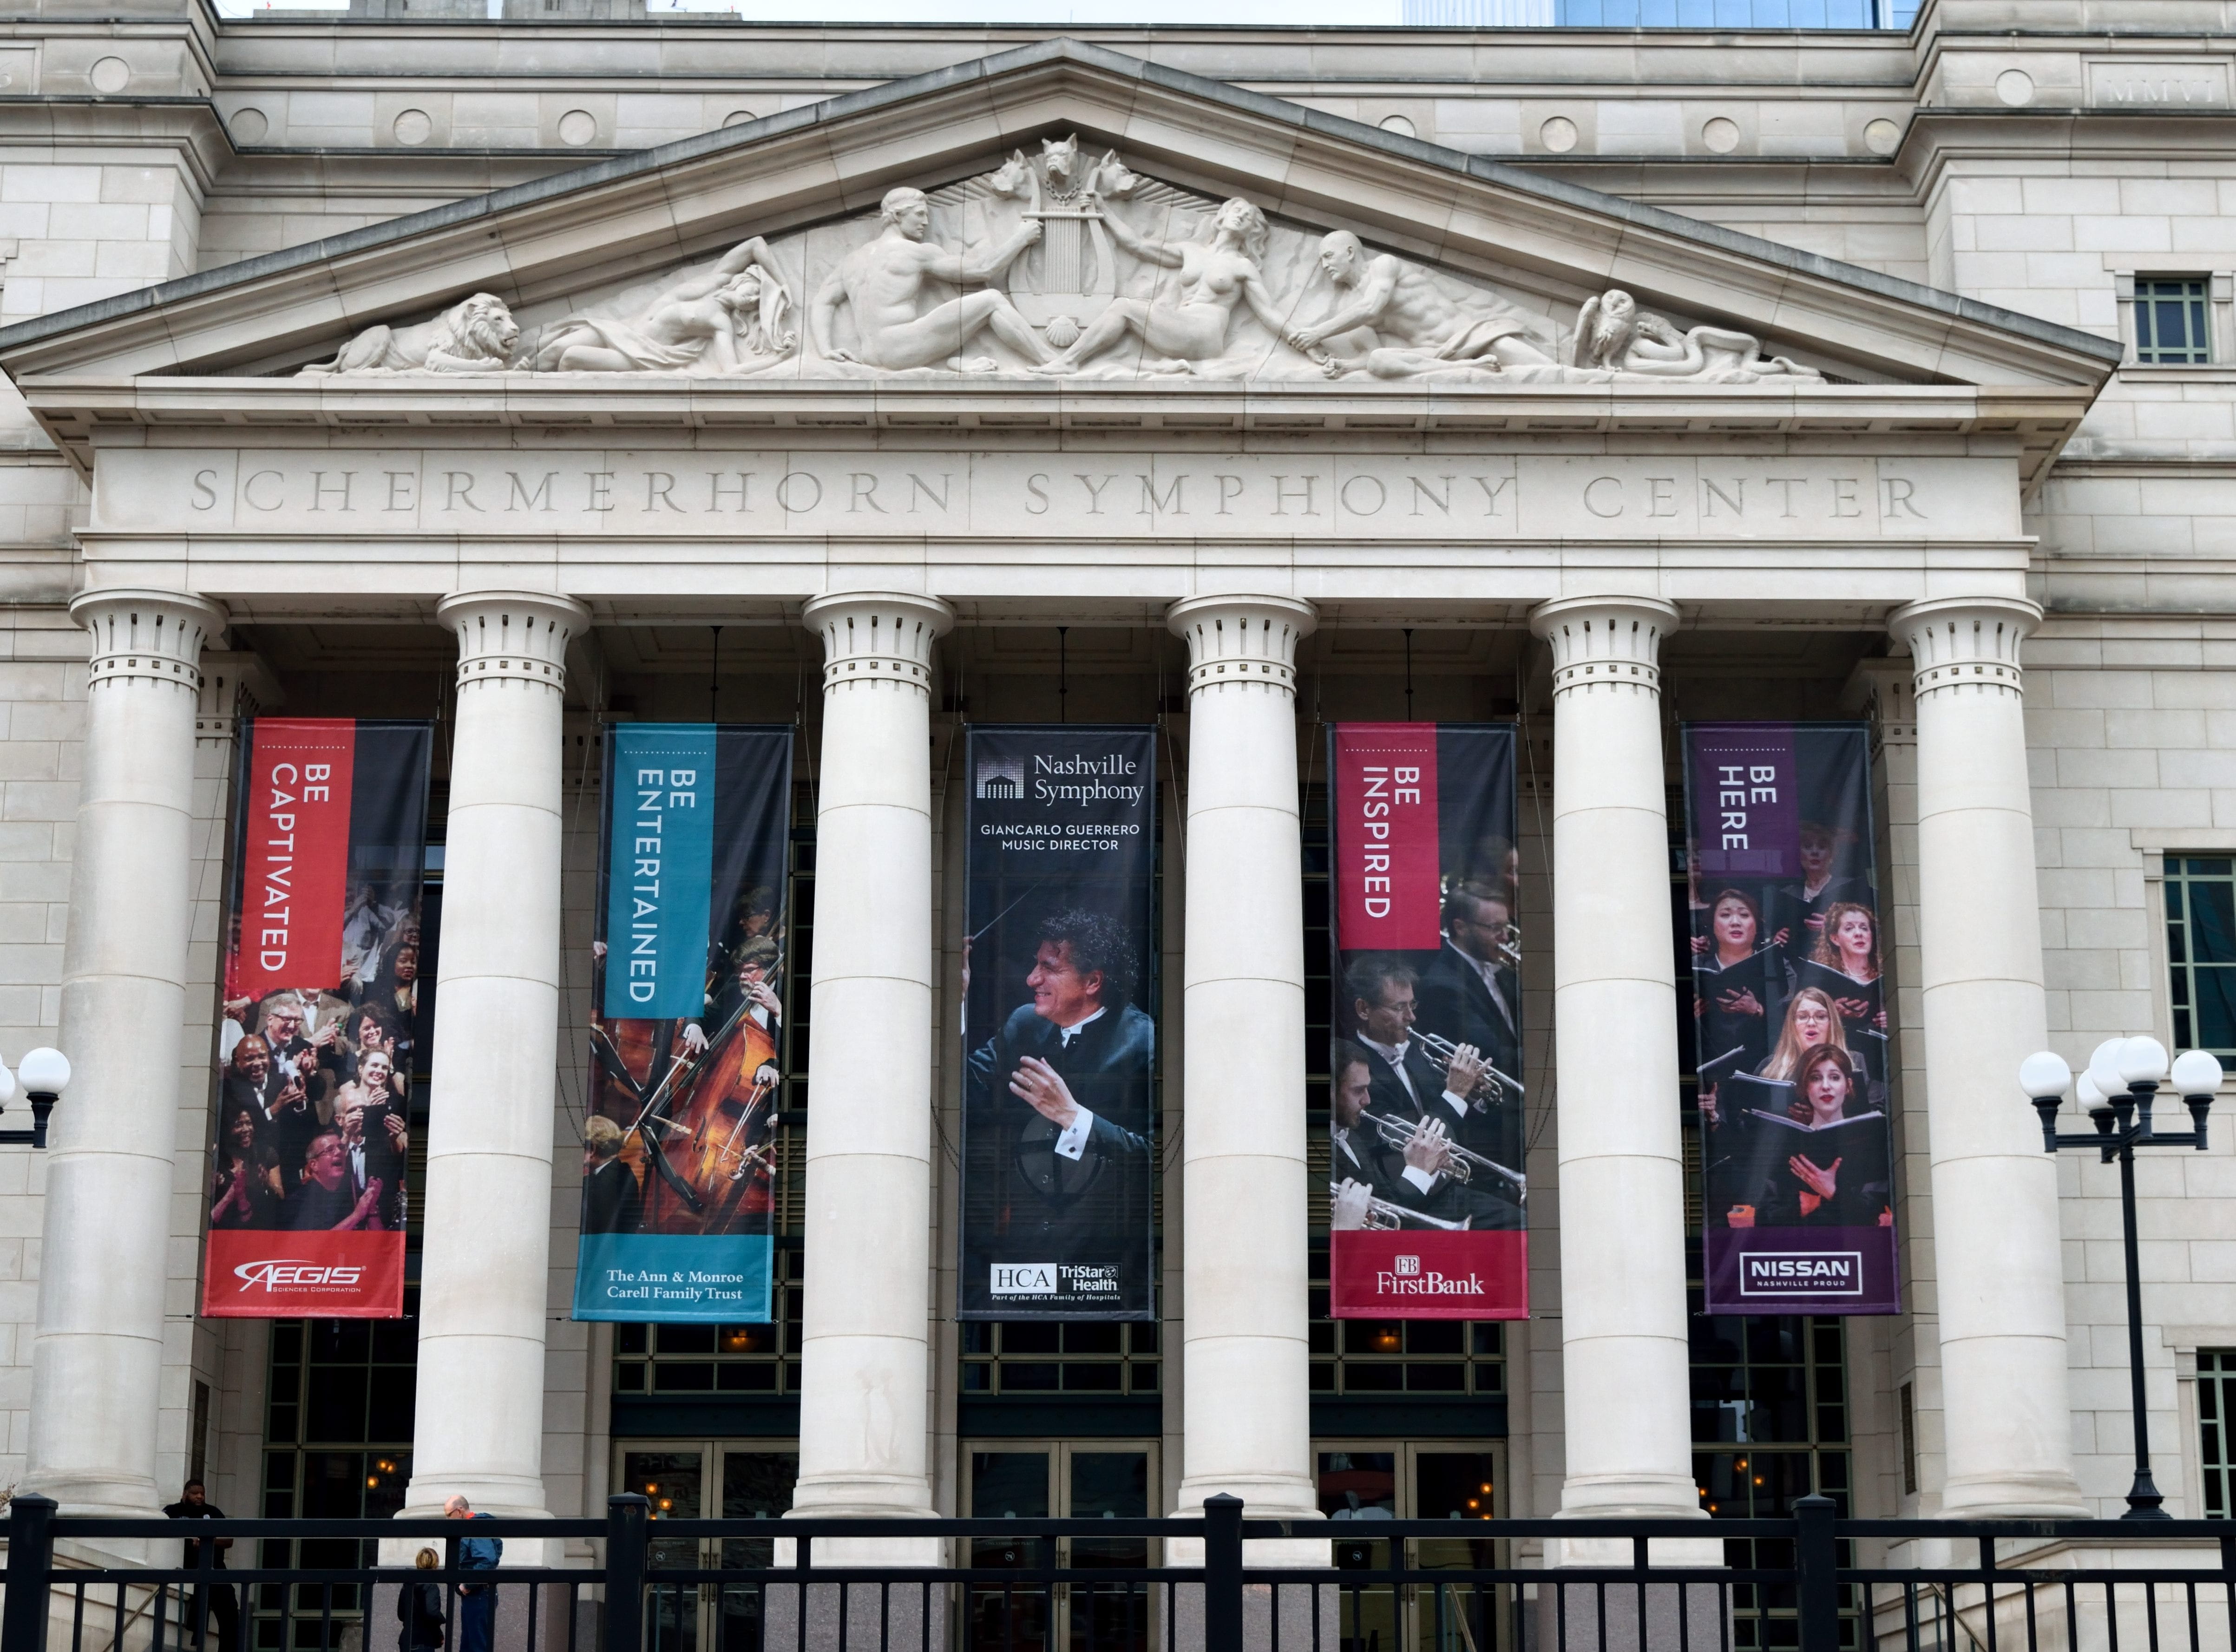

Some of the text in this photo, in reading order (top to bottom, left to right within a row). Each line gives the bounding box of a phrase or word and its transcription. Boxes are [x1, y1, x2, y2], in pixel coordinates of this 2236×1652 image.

[2106, 80, 2214, 103] MMVI
[191, 470, 1928, 518] SCHERMERHORN SYMPHONY CENTER
[1034, 754, 1136, 774] Nashville
[304, 764, 330, 802] BE
[670, 769, 696, 808] BE
[1035, 779, 1144, 806] Symphony
[1395, 767, 1420, 805] BE
[1750, 766, 1777, 804] BE
[1719, 766, 1748, 850] HERE
[981, 825, 1140, 835] GIANCARLO GUERRERO
[1002, 840, 1118, 850] MUSIC DIRECTOR
[1364, 767, 1390, 918] INSPIRED
[261, 763, 298, 971] CAPTIVATED
[629, 769, 663, 1002] ENTERTAINED
[607, 1270, 743, 1283] The Ann & Monroe
[1059, 1266, 1104, 1278] TriStar
[1398, 1259, 1416, 1272] FB
[1751, 1261, 1849, 1277] NISSAN
[996, 1269, 1050, 1287] HCA
[1073, 1279, 1117, 1291] Health
[1377, 1272, 1484, 1294] FirstBank
[607, 1286, 742, 1302] Carell Family Trust
